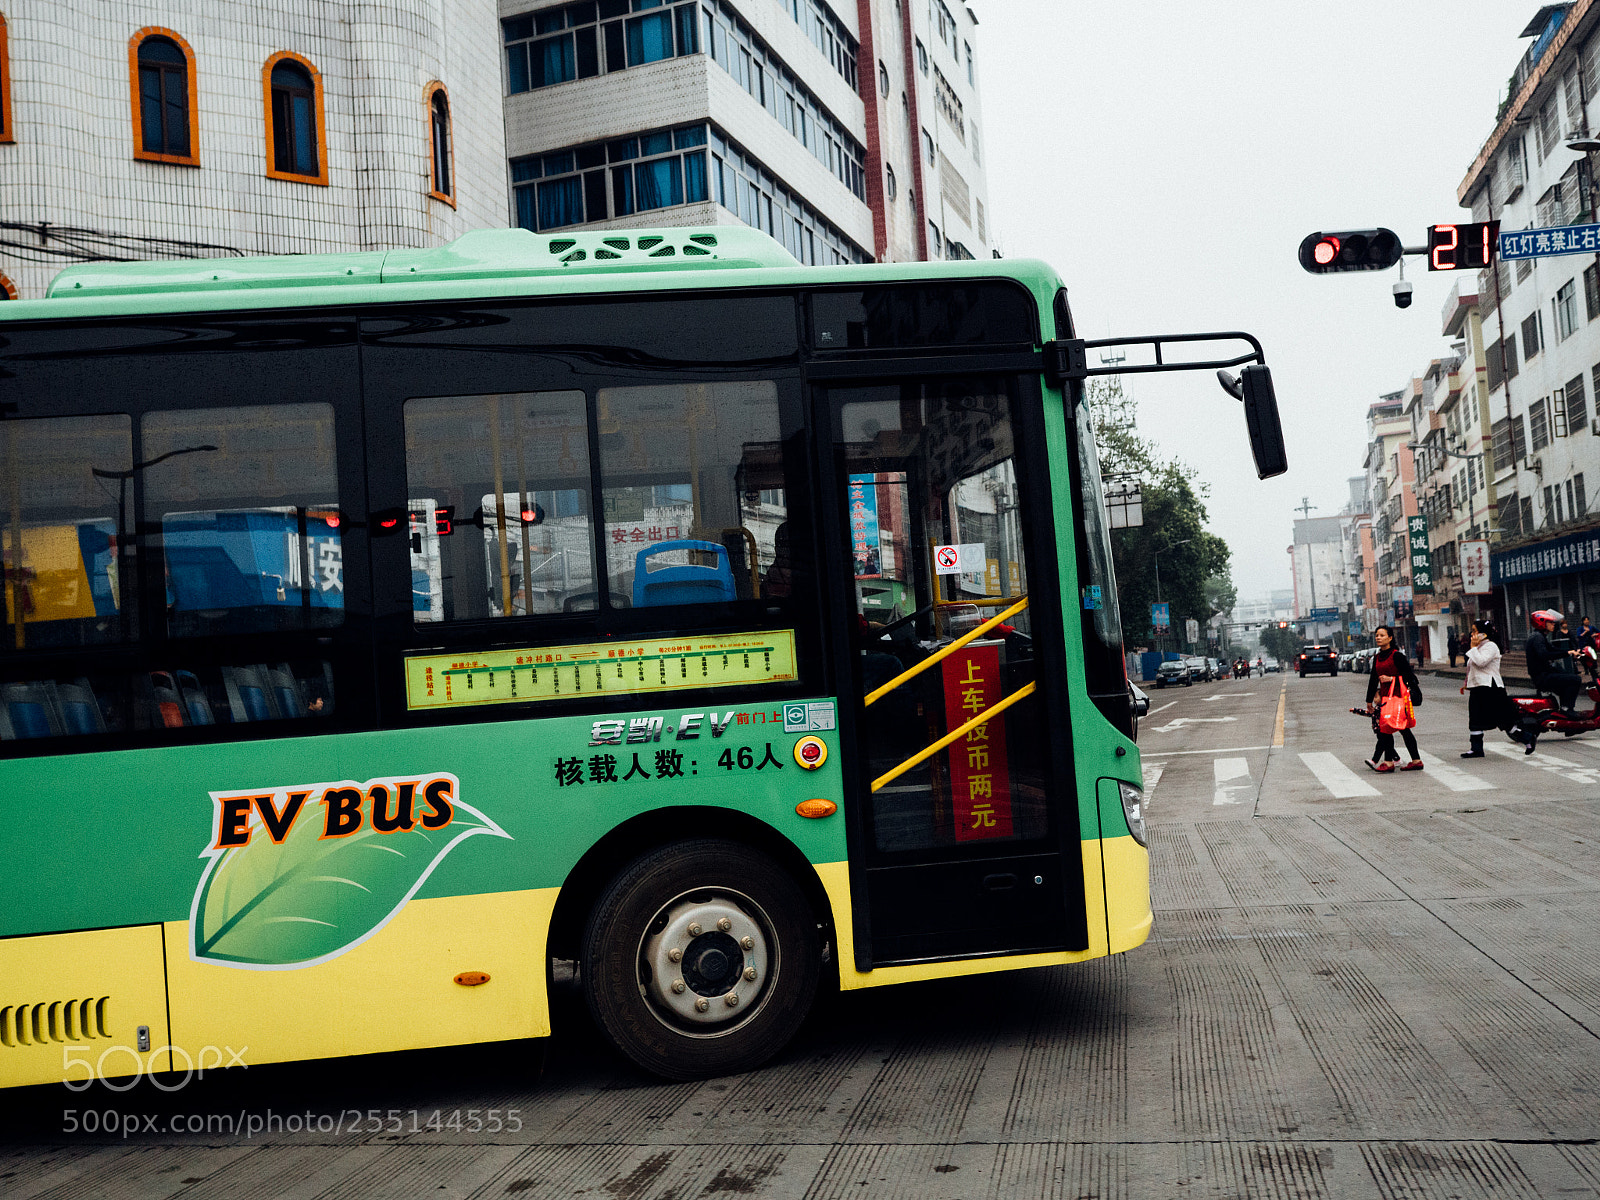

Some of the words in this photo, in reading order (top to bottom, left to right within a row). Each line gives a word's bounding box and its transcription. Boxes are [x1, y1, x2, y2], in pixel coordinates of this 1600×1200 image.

[1432, 225, 1489, 270] 21
[1504, 227, 1600, 257] 红灯亮禁止右
[611, 526, 680, 544] 安全出口
[1409, 517, 1432, 586] 贵诚眼镜
[607, 647, 645, 658] 顺德小学
[735, 711, 783, 725] 前门上
[959, 659, 997, 829] 上车投币两元
[212, 789, 315, 850] EV
[317, 778, 455, 842] BUS
